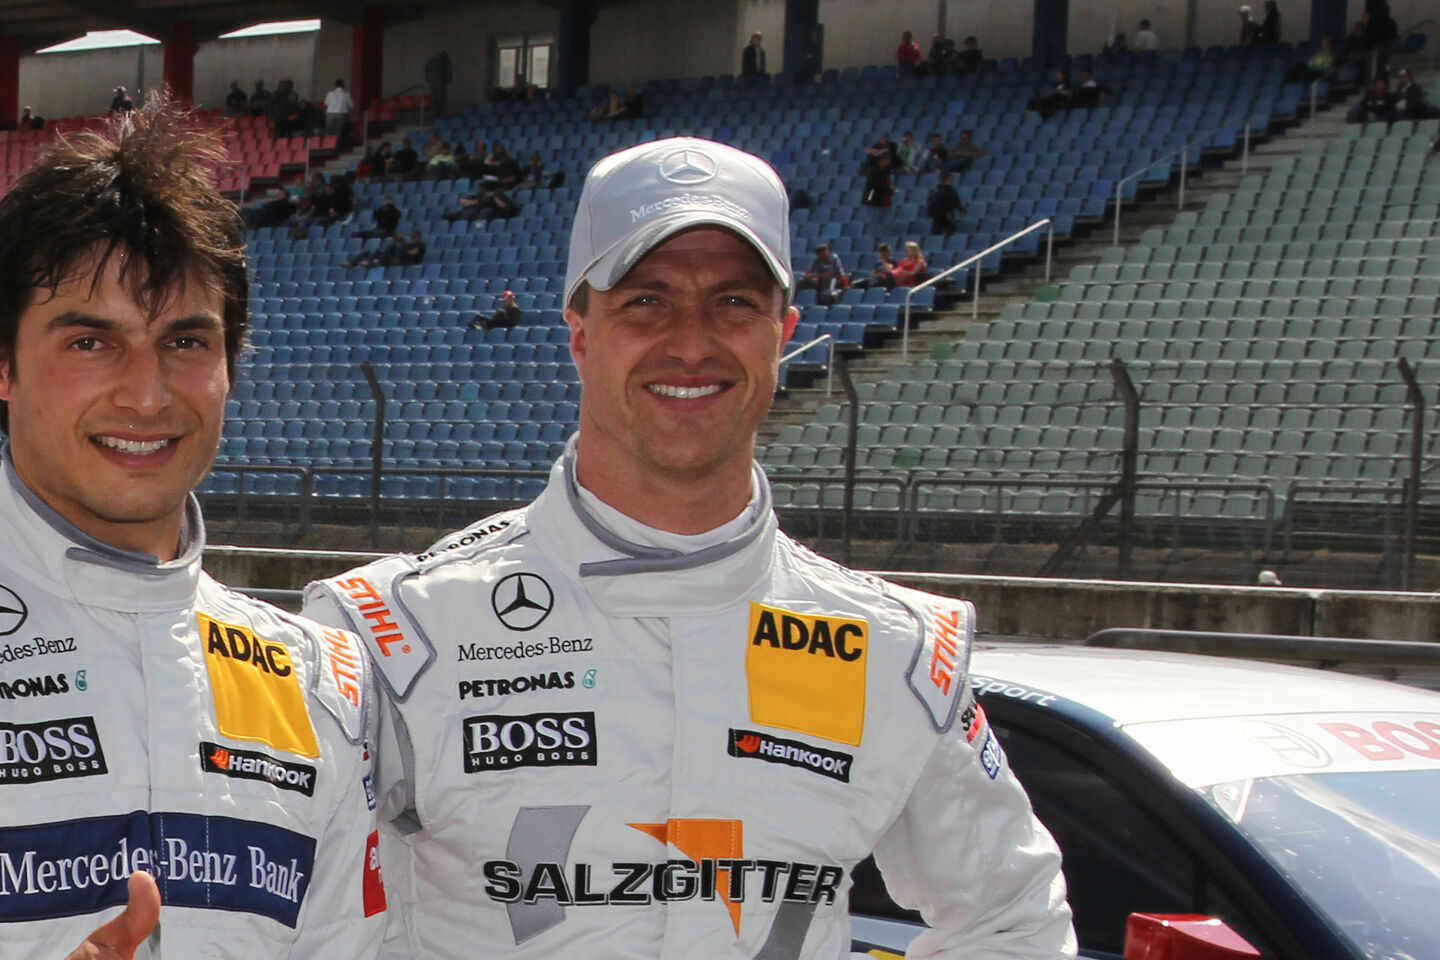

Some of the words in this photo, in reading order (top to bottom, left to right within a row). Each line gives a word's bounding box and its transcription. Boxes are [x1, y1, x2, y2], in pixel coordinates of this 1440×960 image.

[336, 577, 405, 658] STIHL
[753, 610, 864, 662] ADAC
[207, 621, 291, 677] ADAC
[323, 630, 359, 707] STIHL
[458, 637, 593, 662] Mercedes-Benz
[929, 610, 959, 696] STIHL
[459, 671, 575, 700] PETRONAS
[469, 717, 591, 754] BOSS
[53, 759, 100, 774] BOSS
[228, 754, 311, 790] Hankook
[472, 754, 522, 767] HUGO
[537, 751, 589, 761] BOSS
[759, 739, 848, 776] Hankook
[247, 845, 305, 904] Bank
[483, 859, 844, 906] SALZGITTER
